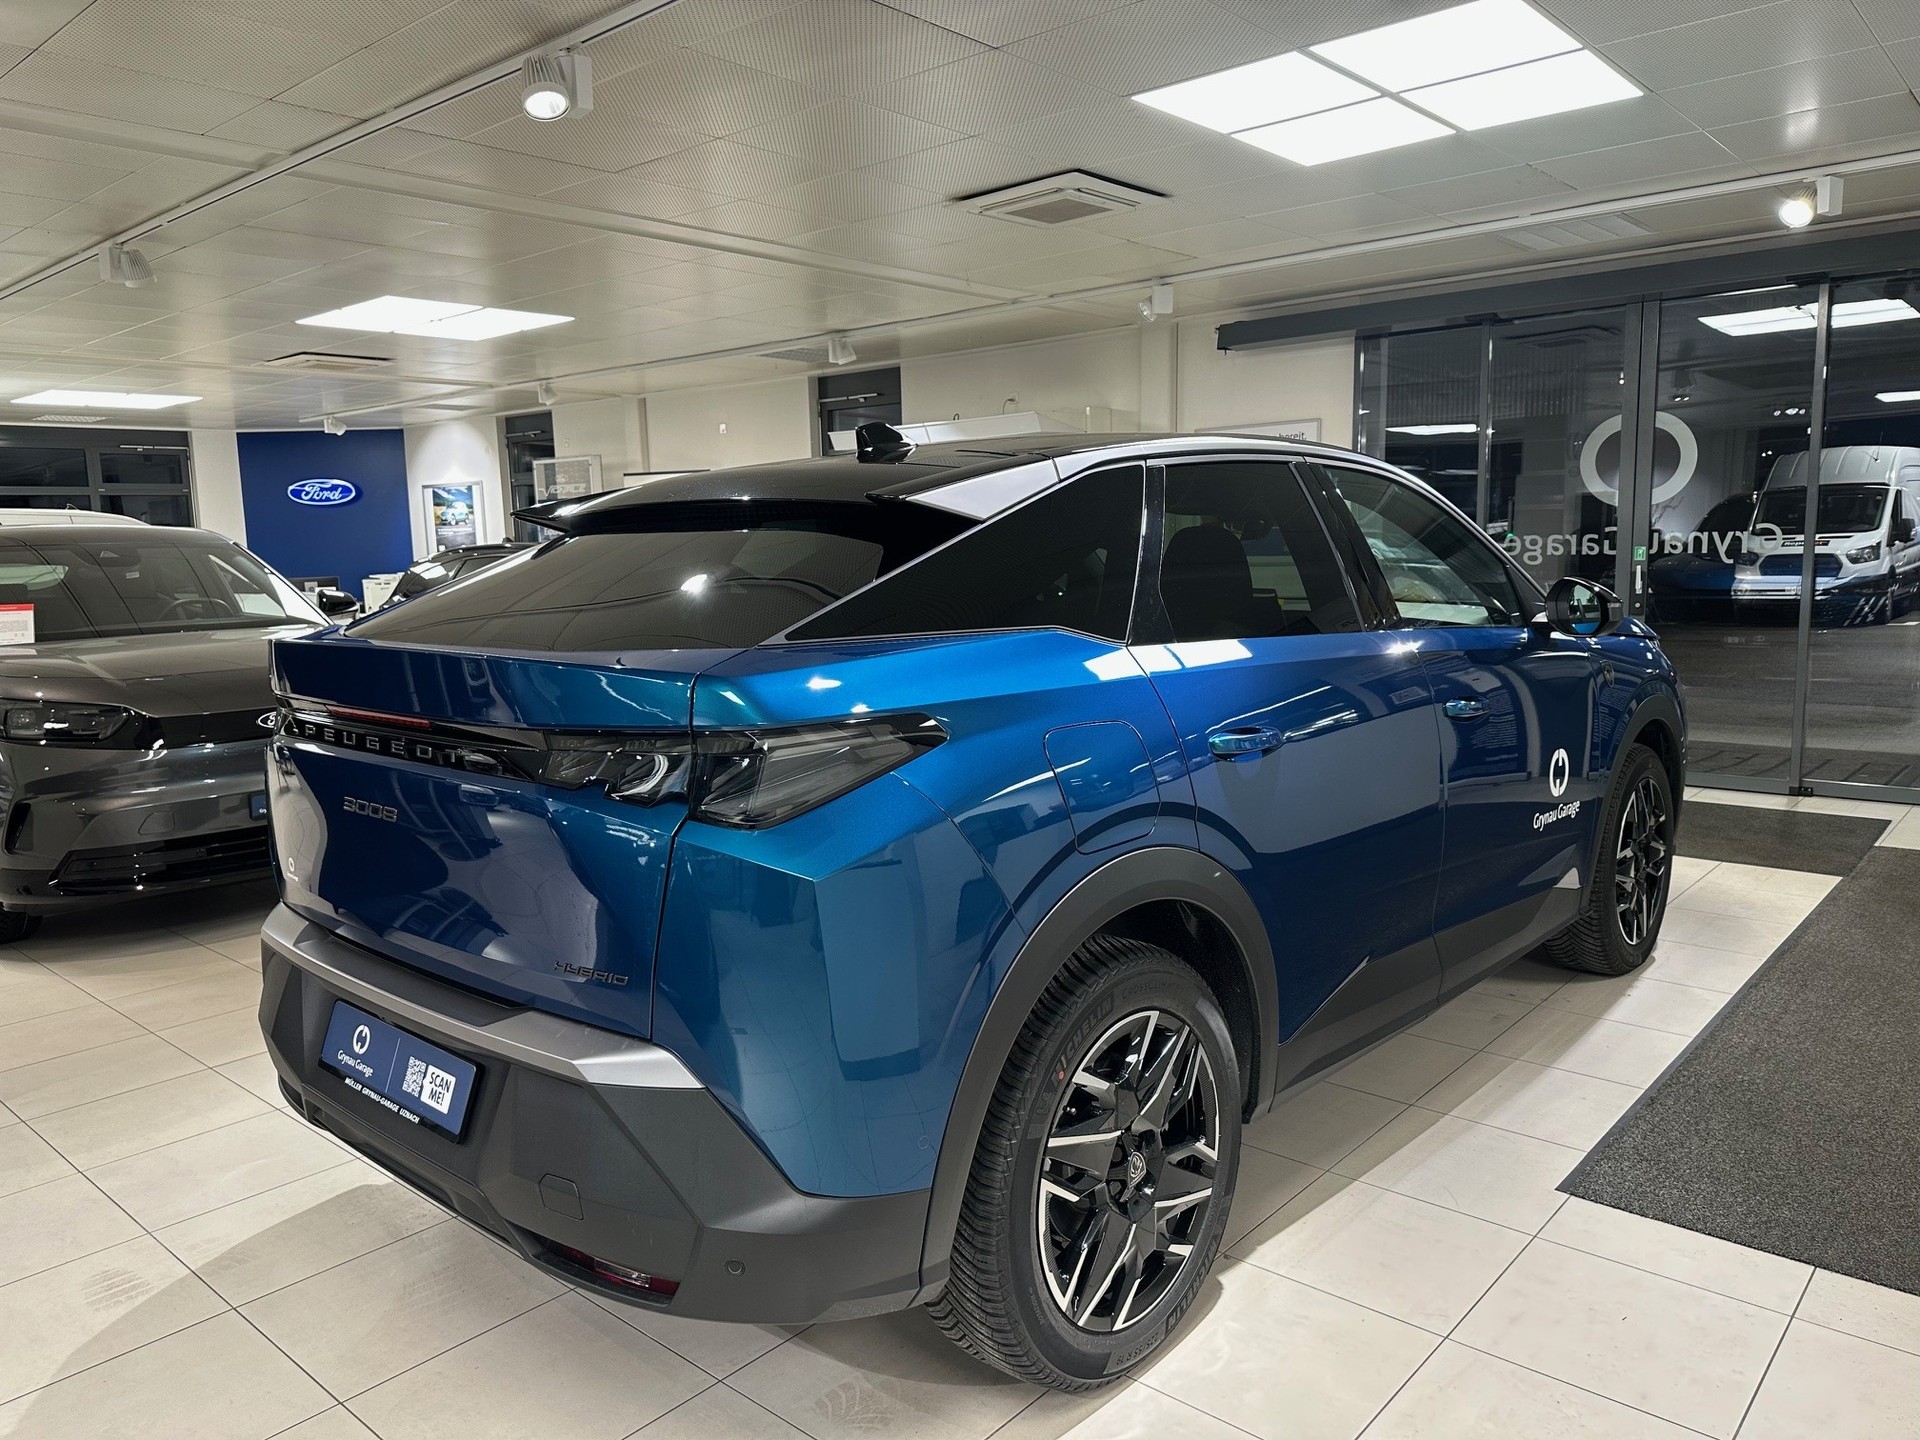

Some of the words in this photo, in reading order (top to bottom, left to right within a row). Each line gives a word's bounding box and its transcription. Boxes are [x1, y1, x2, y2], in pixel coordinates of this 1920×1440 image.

[300, 483, 342, 501] Ford
[305, 724, 462, 763] PEUGEOT
[343, 796, 398, 823] 3008
[1533, 809, 1557, 832] Grynau
[1557, 800, 1580, 819] Garage
[554, 960, 629, 986] HYBRID
[1050, 997, 1113, 1088] MICHELIN
[337, 1049, 356, 1067] Grynau
[355, 1059, 374, 1078] Garage
[428, 1087, 445, 1106] ME!
[429, 1071, 452, 1093] SCAN
[344, 1076, 363, 1092] MÜLLER
[362, 1087, 400, 1113] GRYNAU-GARAGE
[399, 1107, 420, 1124] UZNACH
[1167, 1238, 1217, 1332] MICHELIN
